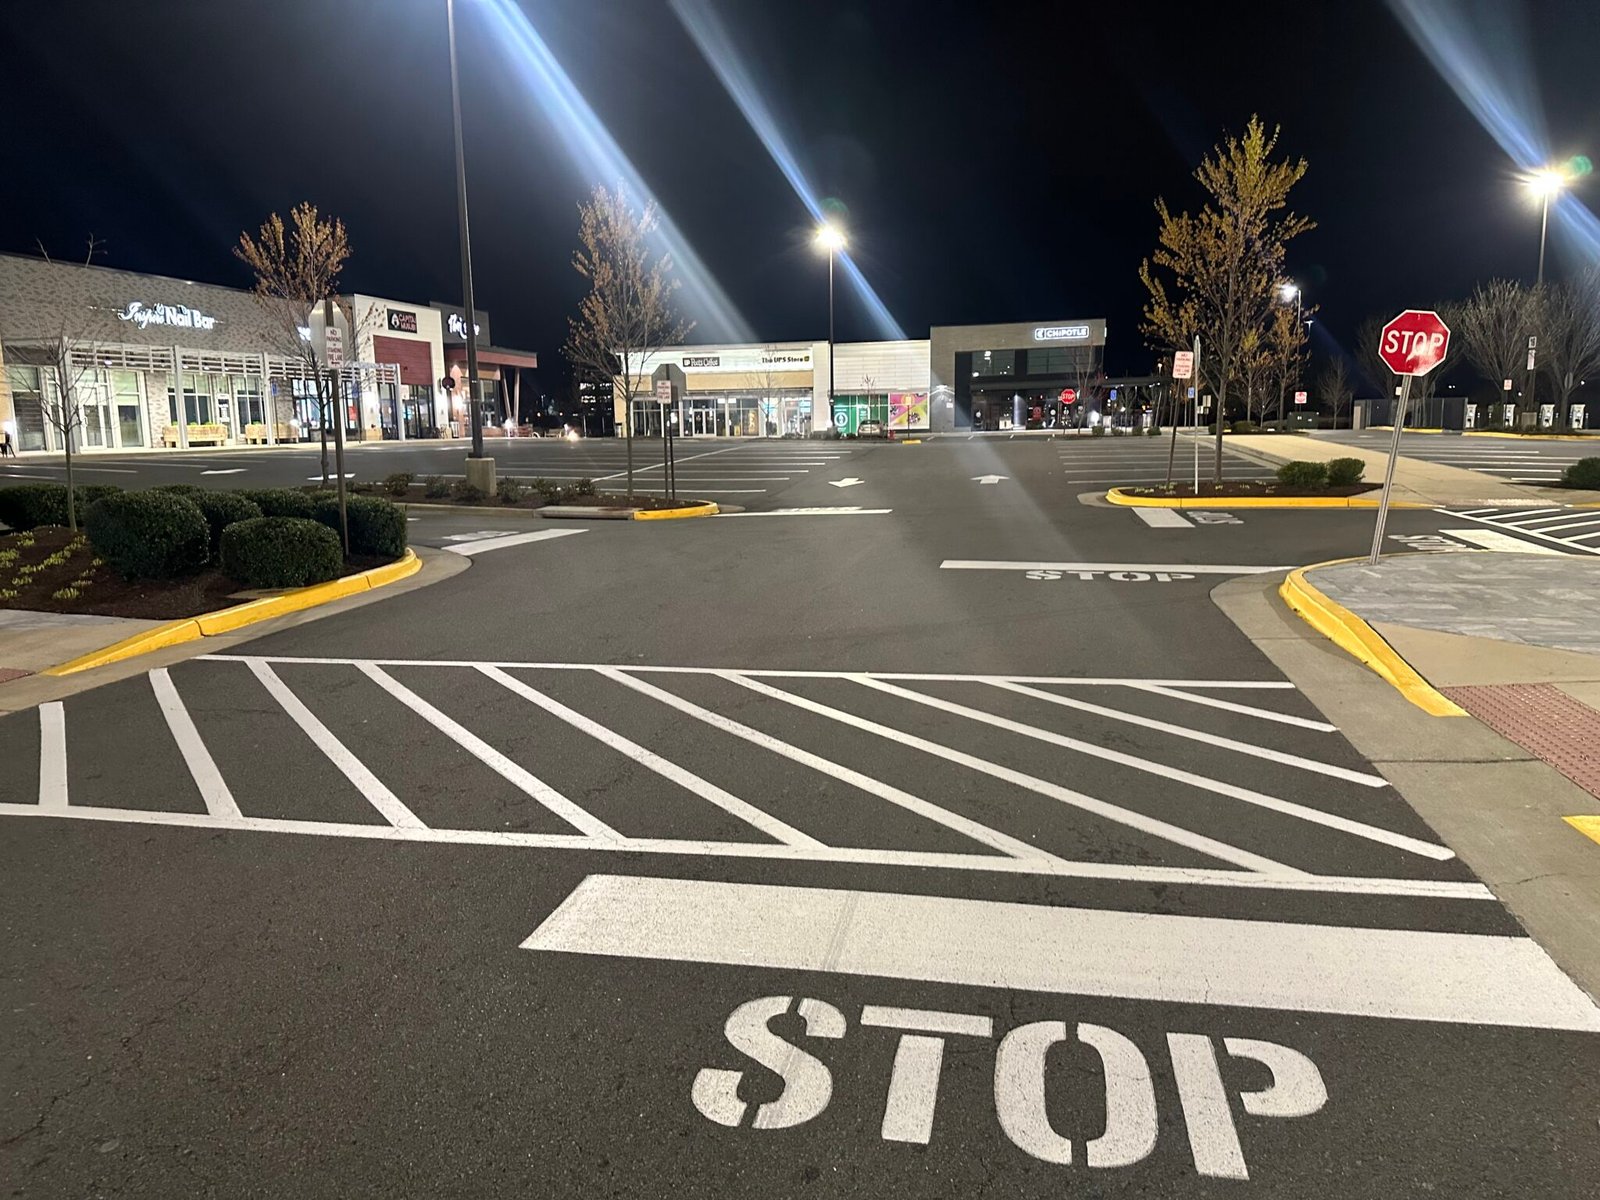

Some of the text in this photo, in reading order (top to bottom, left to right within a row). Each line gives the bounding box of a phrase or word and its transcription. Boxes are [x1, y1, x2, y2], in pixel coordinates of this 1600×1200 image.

[164, 305, 191, 328] Nail
[192, 309, 214, 329] Bar
[1046, 328, 1087, 338] CHIPOTLE
[1384, 329, 1445, 356] STOP
[1061, 392, 1075, 400] STOP
[1025, 570, 1196, 583] STOP
[691, 995, 1329, 1181] STOP
